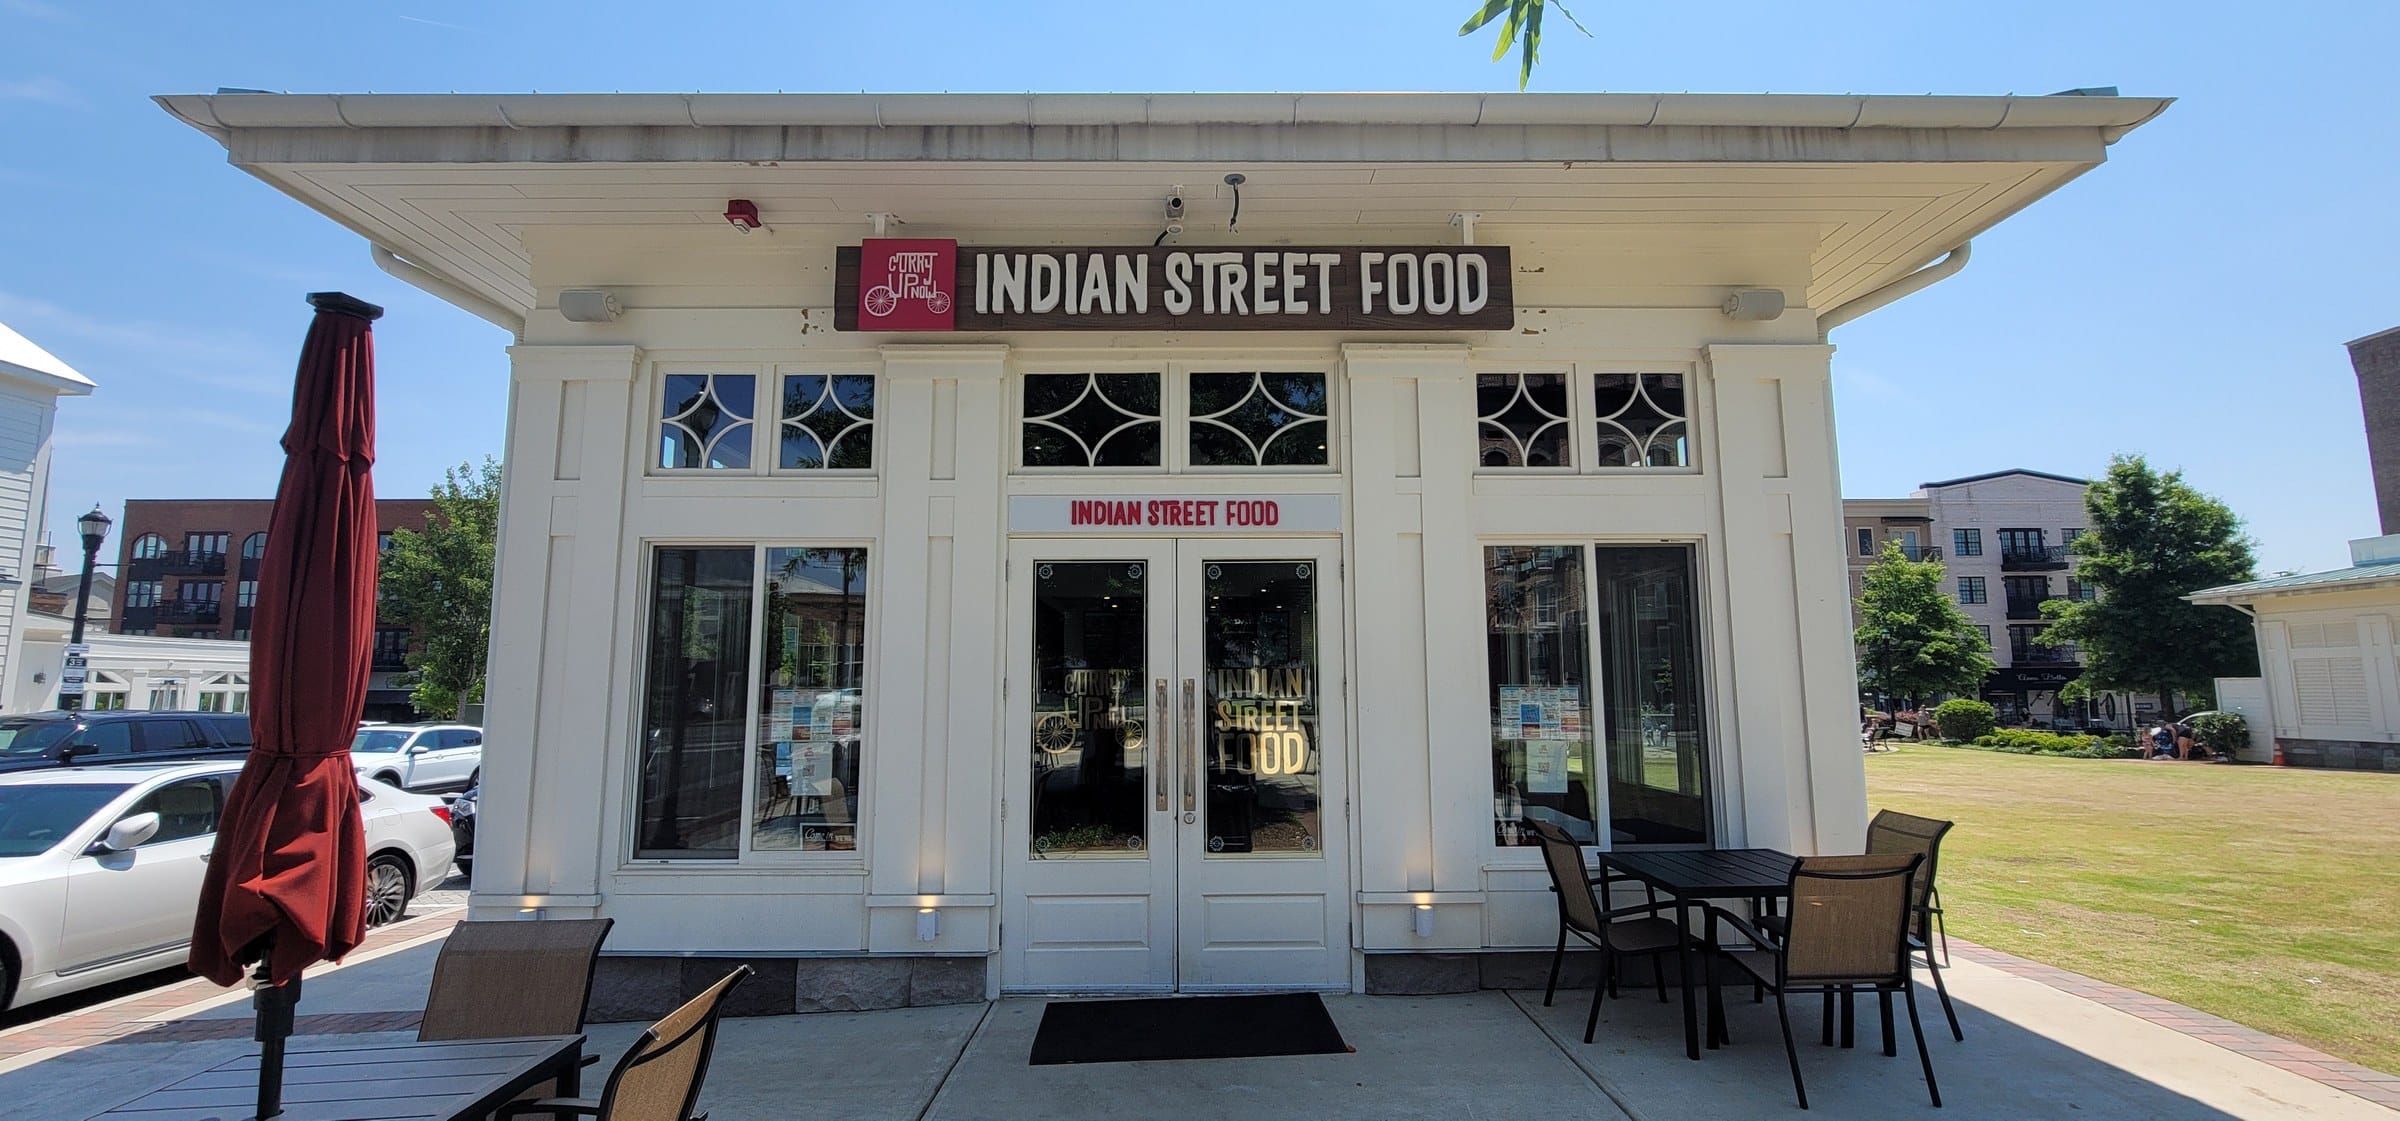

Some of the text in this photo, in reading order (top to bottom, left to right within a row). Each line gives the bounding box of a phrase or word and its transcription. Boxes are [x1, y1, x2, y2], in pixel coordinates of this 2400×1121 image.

[888, 252, 938, 286] CURRY
[975, 252, 1489, 316] INDIAN STREET FOOD
[888, 273, 919, 299] UP
[911, 280, 937, 299] NOW
[1071, 500, 1279, 526] INDIAN STREET FOOD
[1218, 668, 1303, 699] INDIAN
[1217, 700, 1304, 732] STREET
[1218, 732, 1304, 775] FOOD
